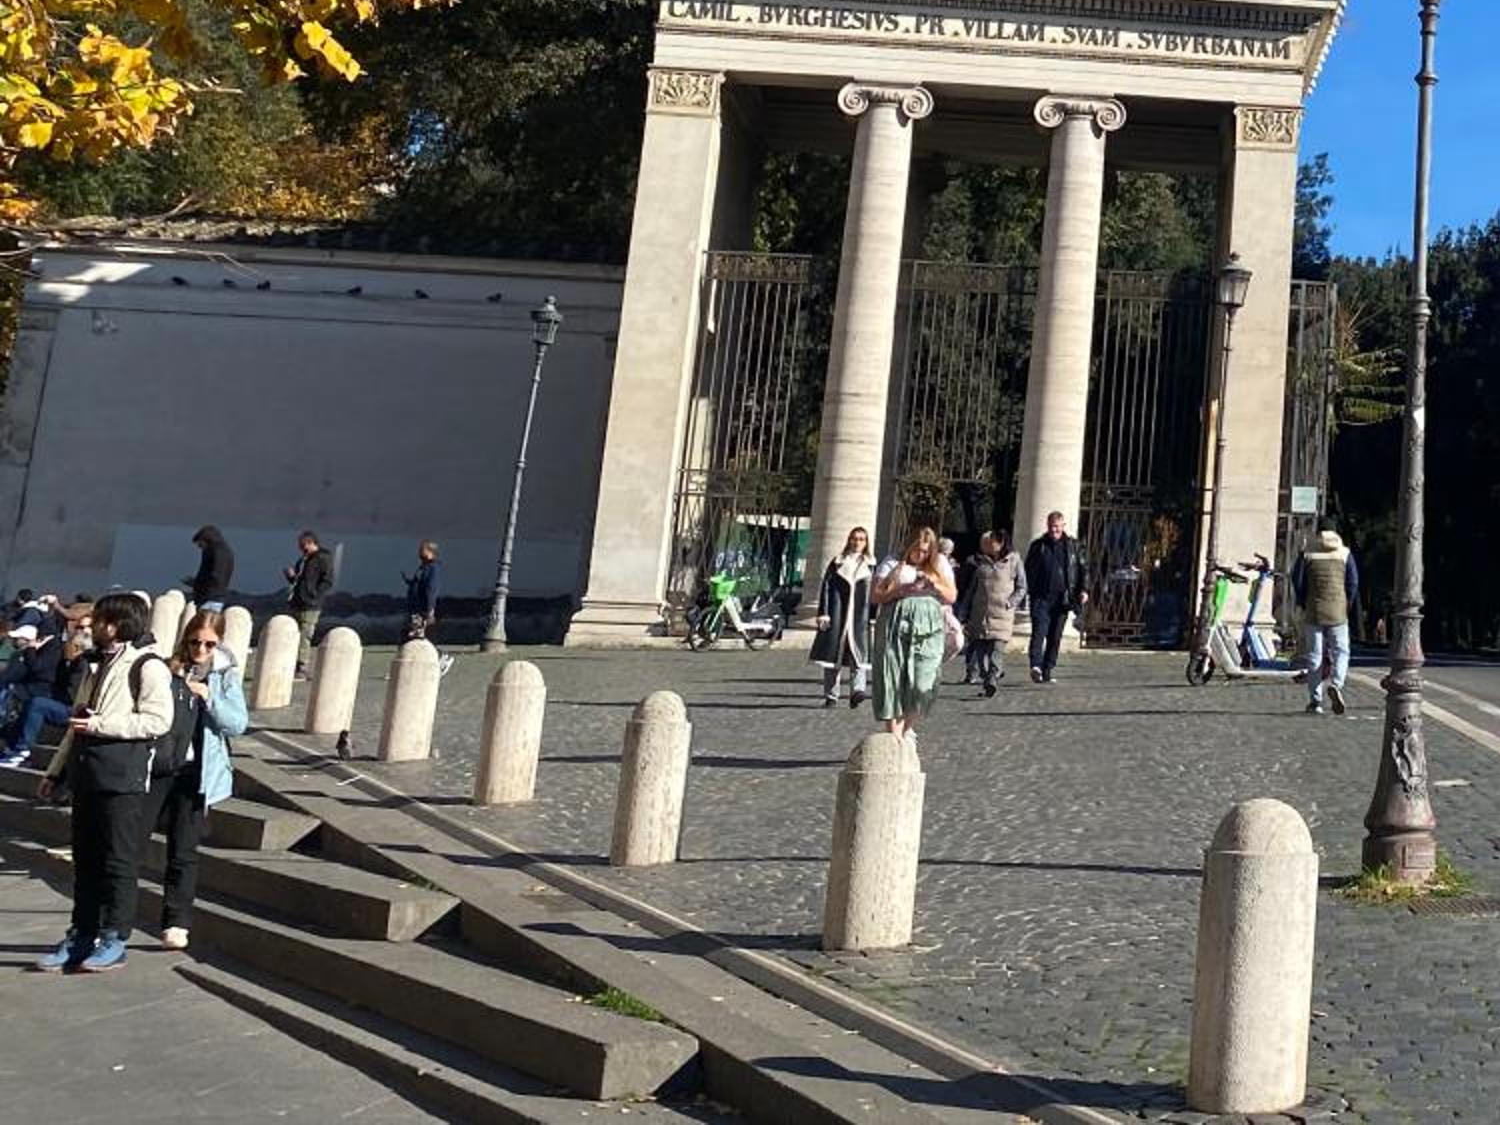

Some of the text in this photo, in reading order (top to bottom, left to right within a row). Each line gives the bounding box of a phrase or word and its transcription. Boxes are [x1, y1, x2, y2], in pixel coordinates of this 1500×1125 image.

[758, 3, 899, 31] BVRGHESIVS
[913, 13, 945, 36] PR
[961, 17, 1045, 42] VILLAM
[1061, 24, 1120, 47] SVAM
[1137, 31, 1290, 59] SVBVRBANAM
